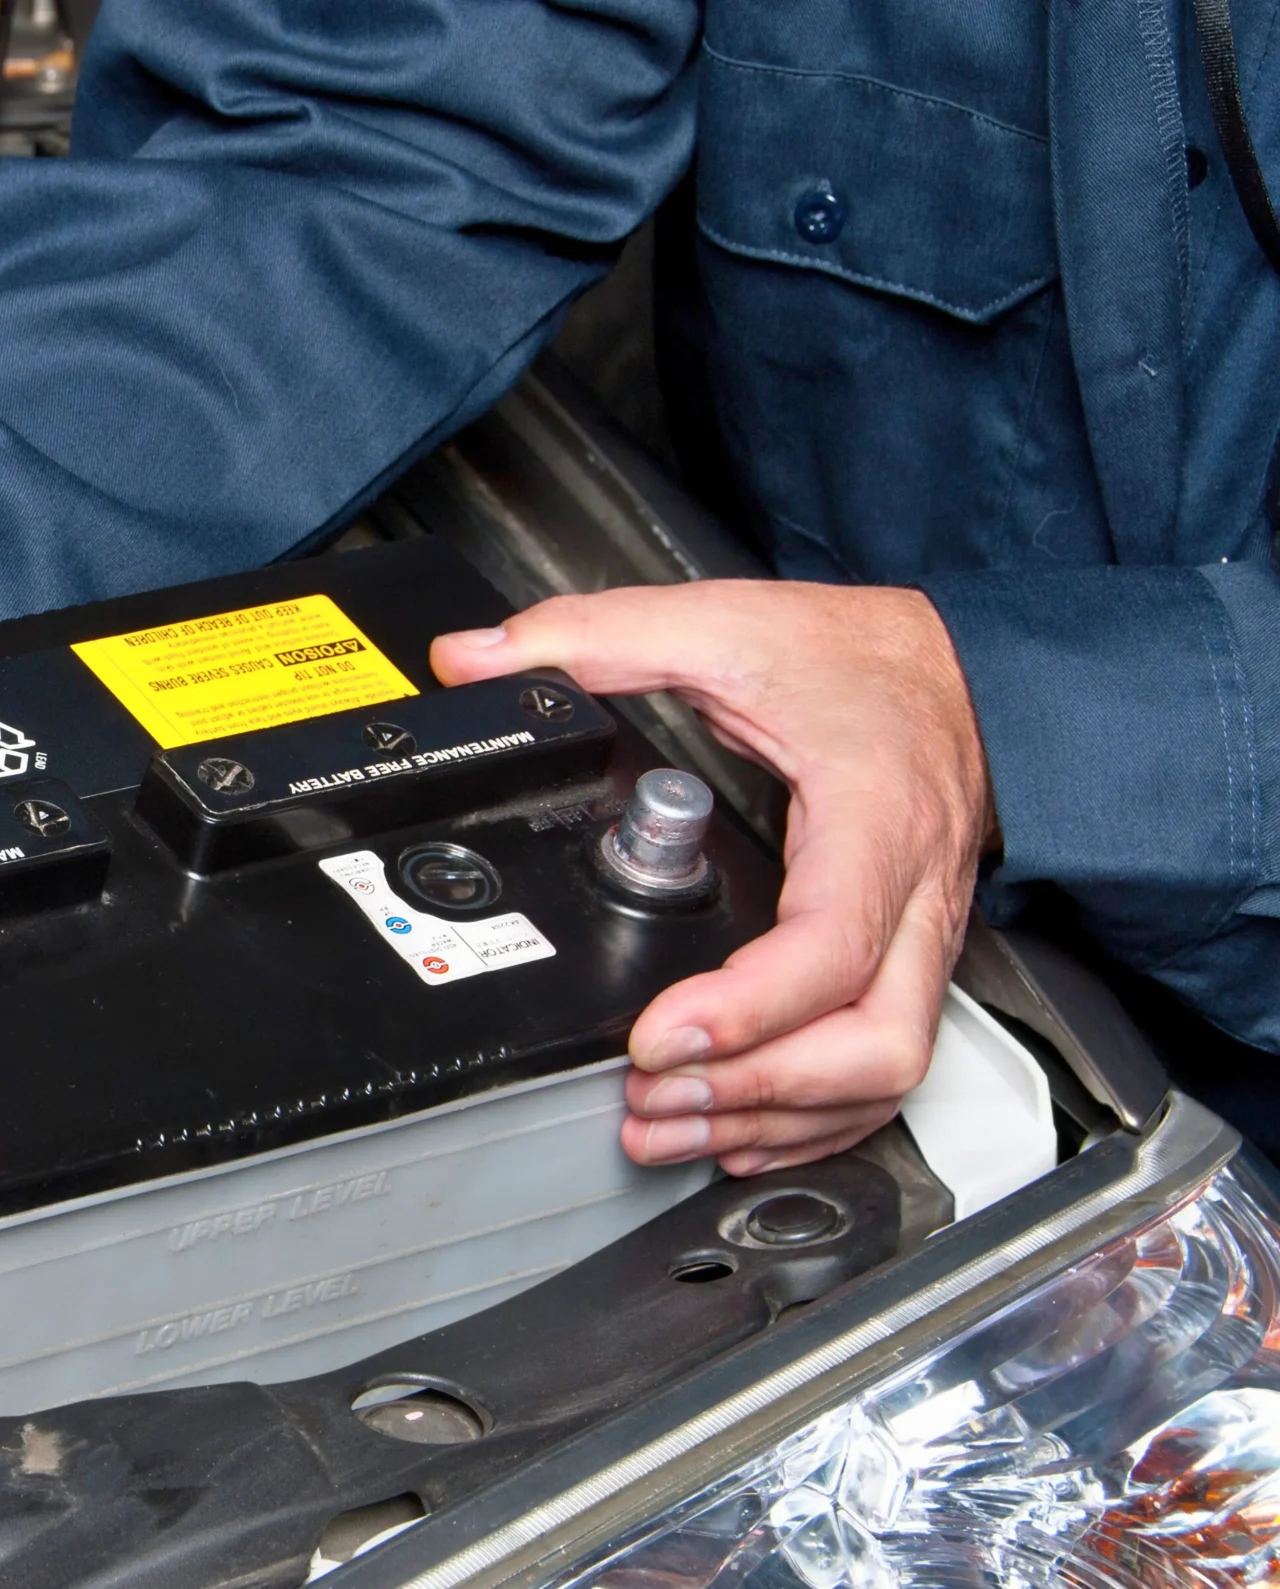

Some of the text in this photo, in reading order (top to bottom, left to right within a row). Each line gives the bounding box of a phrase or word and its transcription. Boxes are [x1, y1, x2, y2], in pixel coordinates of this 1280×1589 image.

[249, 608, 273, 621] OUT
[275, 603, 301, 616] KEEP
[194, 617, 233, 631] REACH
[233, 613, 249, 625] OF
[123, 627, 178, 646] CHILDREN
[180, 624, 196, 635] OF
[278, 642, 345, 664] POISON
[187, 667, 229, 684] SEVERE
[228, 658, 273, 675] CAUSES
[294, 660, 355, 681] DO NOT TIP
[148, 676, 188, 691] BURNS
[34, 751, 48, 770] LEAD
[287, 731, 535, 795] MAINTENANCE FREE BATTERY
[478, 938, 540, 958] INDICATOR
[170, 1171, 393, 1252] UPPER LEVEL
[134, 1273, 359, 1355] LOWER LEVEL
